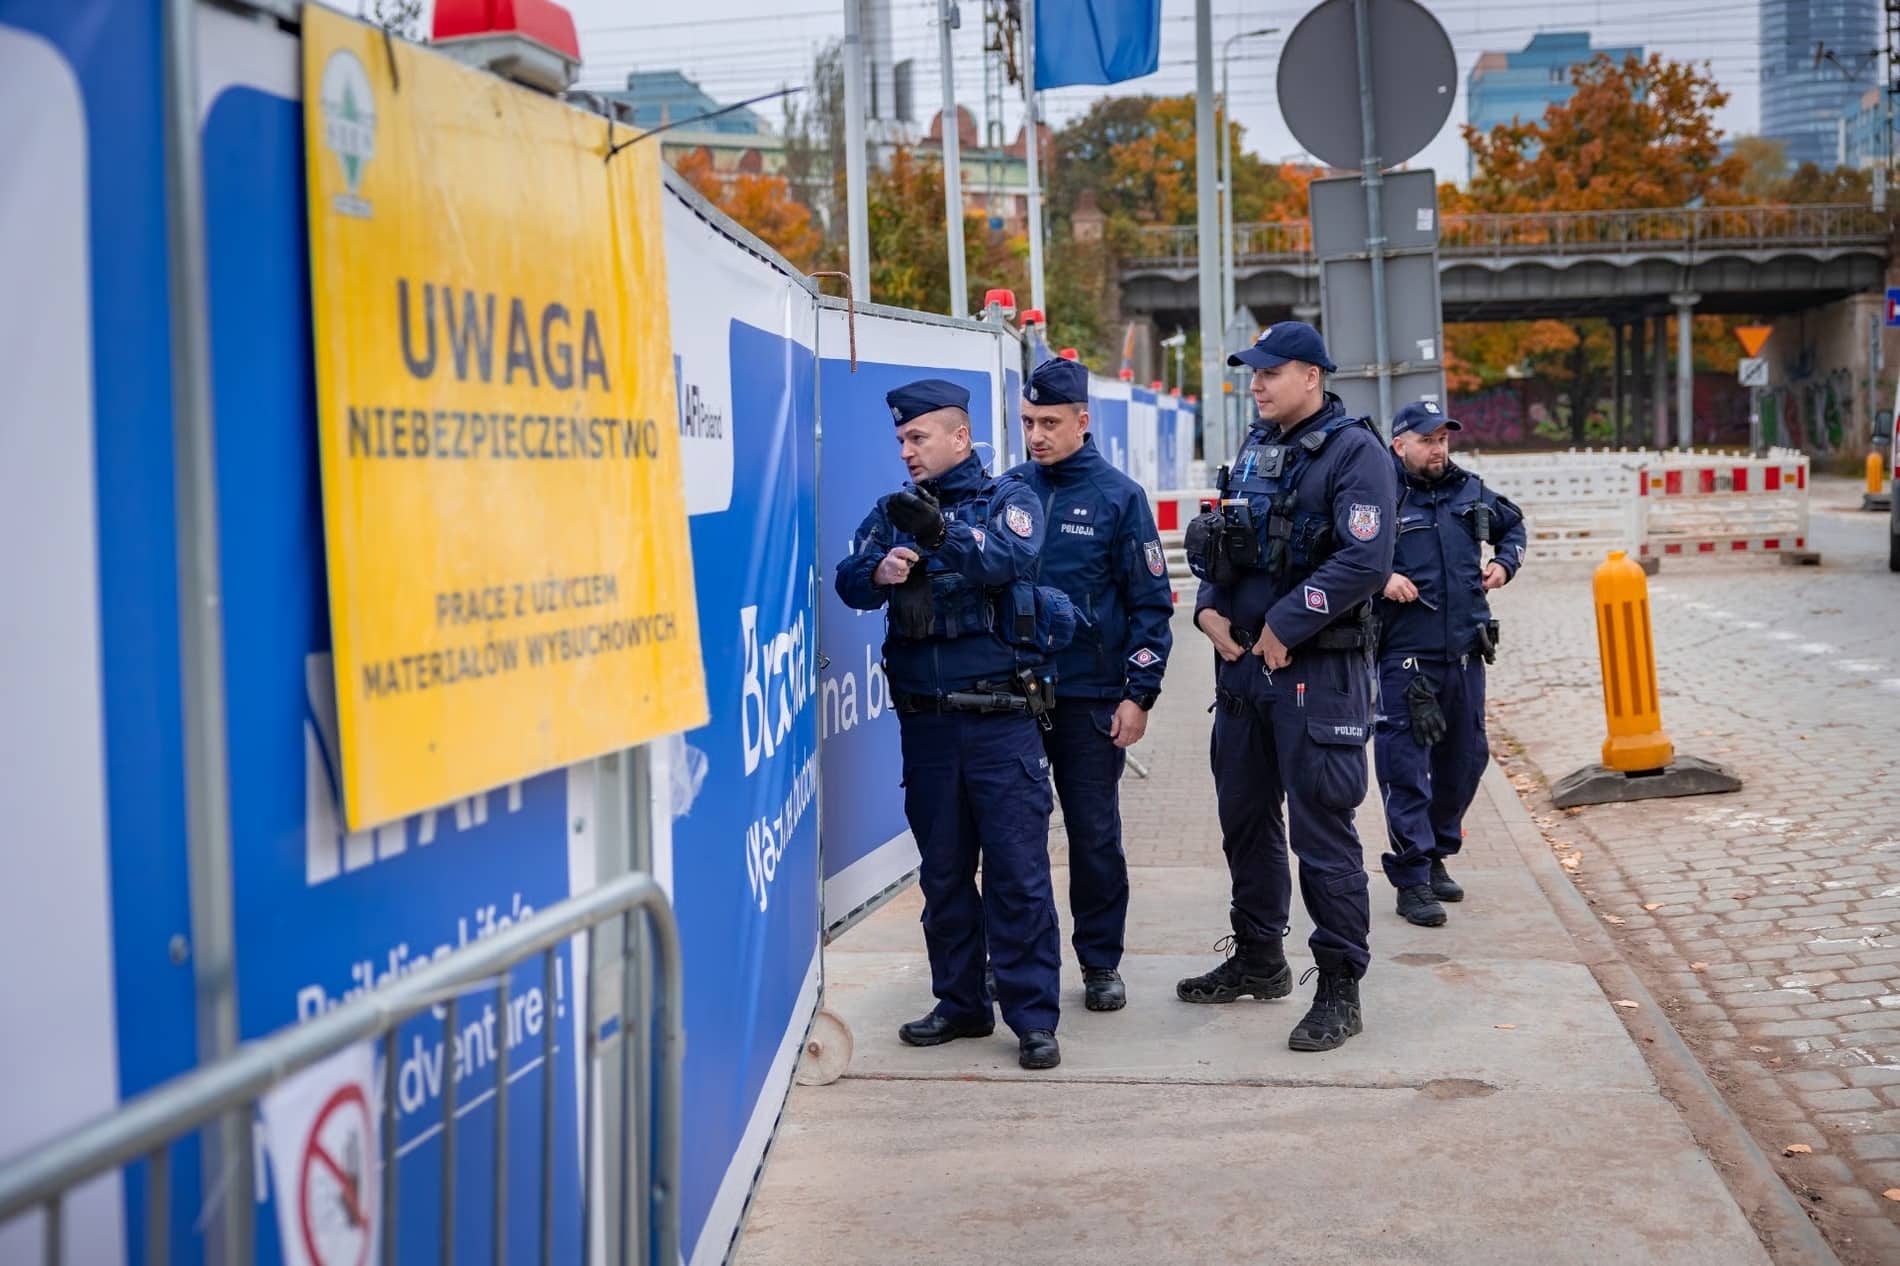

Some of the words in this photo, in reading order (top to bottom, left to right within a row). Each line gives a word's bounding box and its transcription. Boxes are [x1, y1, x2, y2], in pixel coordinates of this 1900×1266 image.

[397, 278, 612, 393] UWAGA
[347, 402, 659, 460] NIEBEZPIECZEŃSTWO
[1060, 523, 1095, 537] POLICJA
[435, 583, 507, 627] PRACE
[513, 583, 526, 618] Z
[530, 572, 619, 614] UŻYCIEM
[361, 629, 519, 699] MATERIAŁÓW
[525, 611, 678, 668] WYBUCHOWYCH
[823, 671, 858, 740] na
